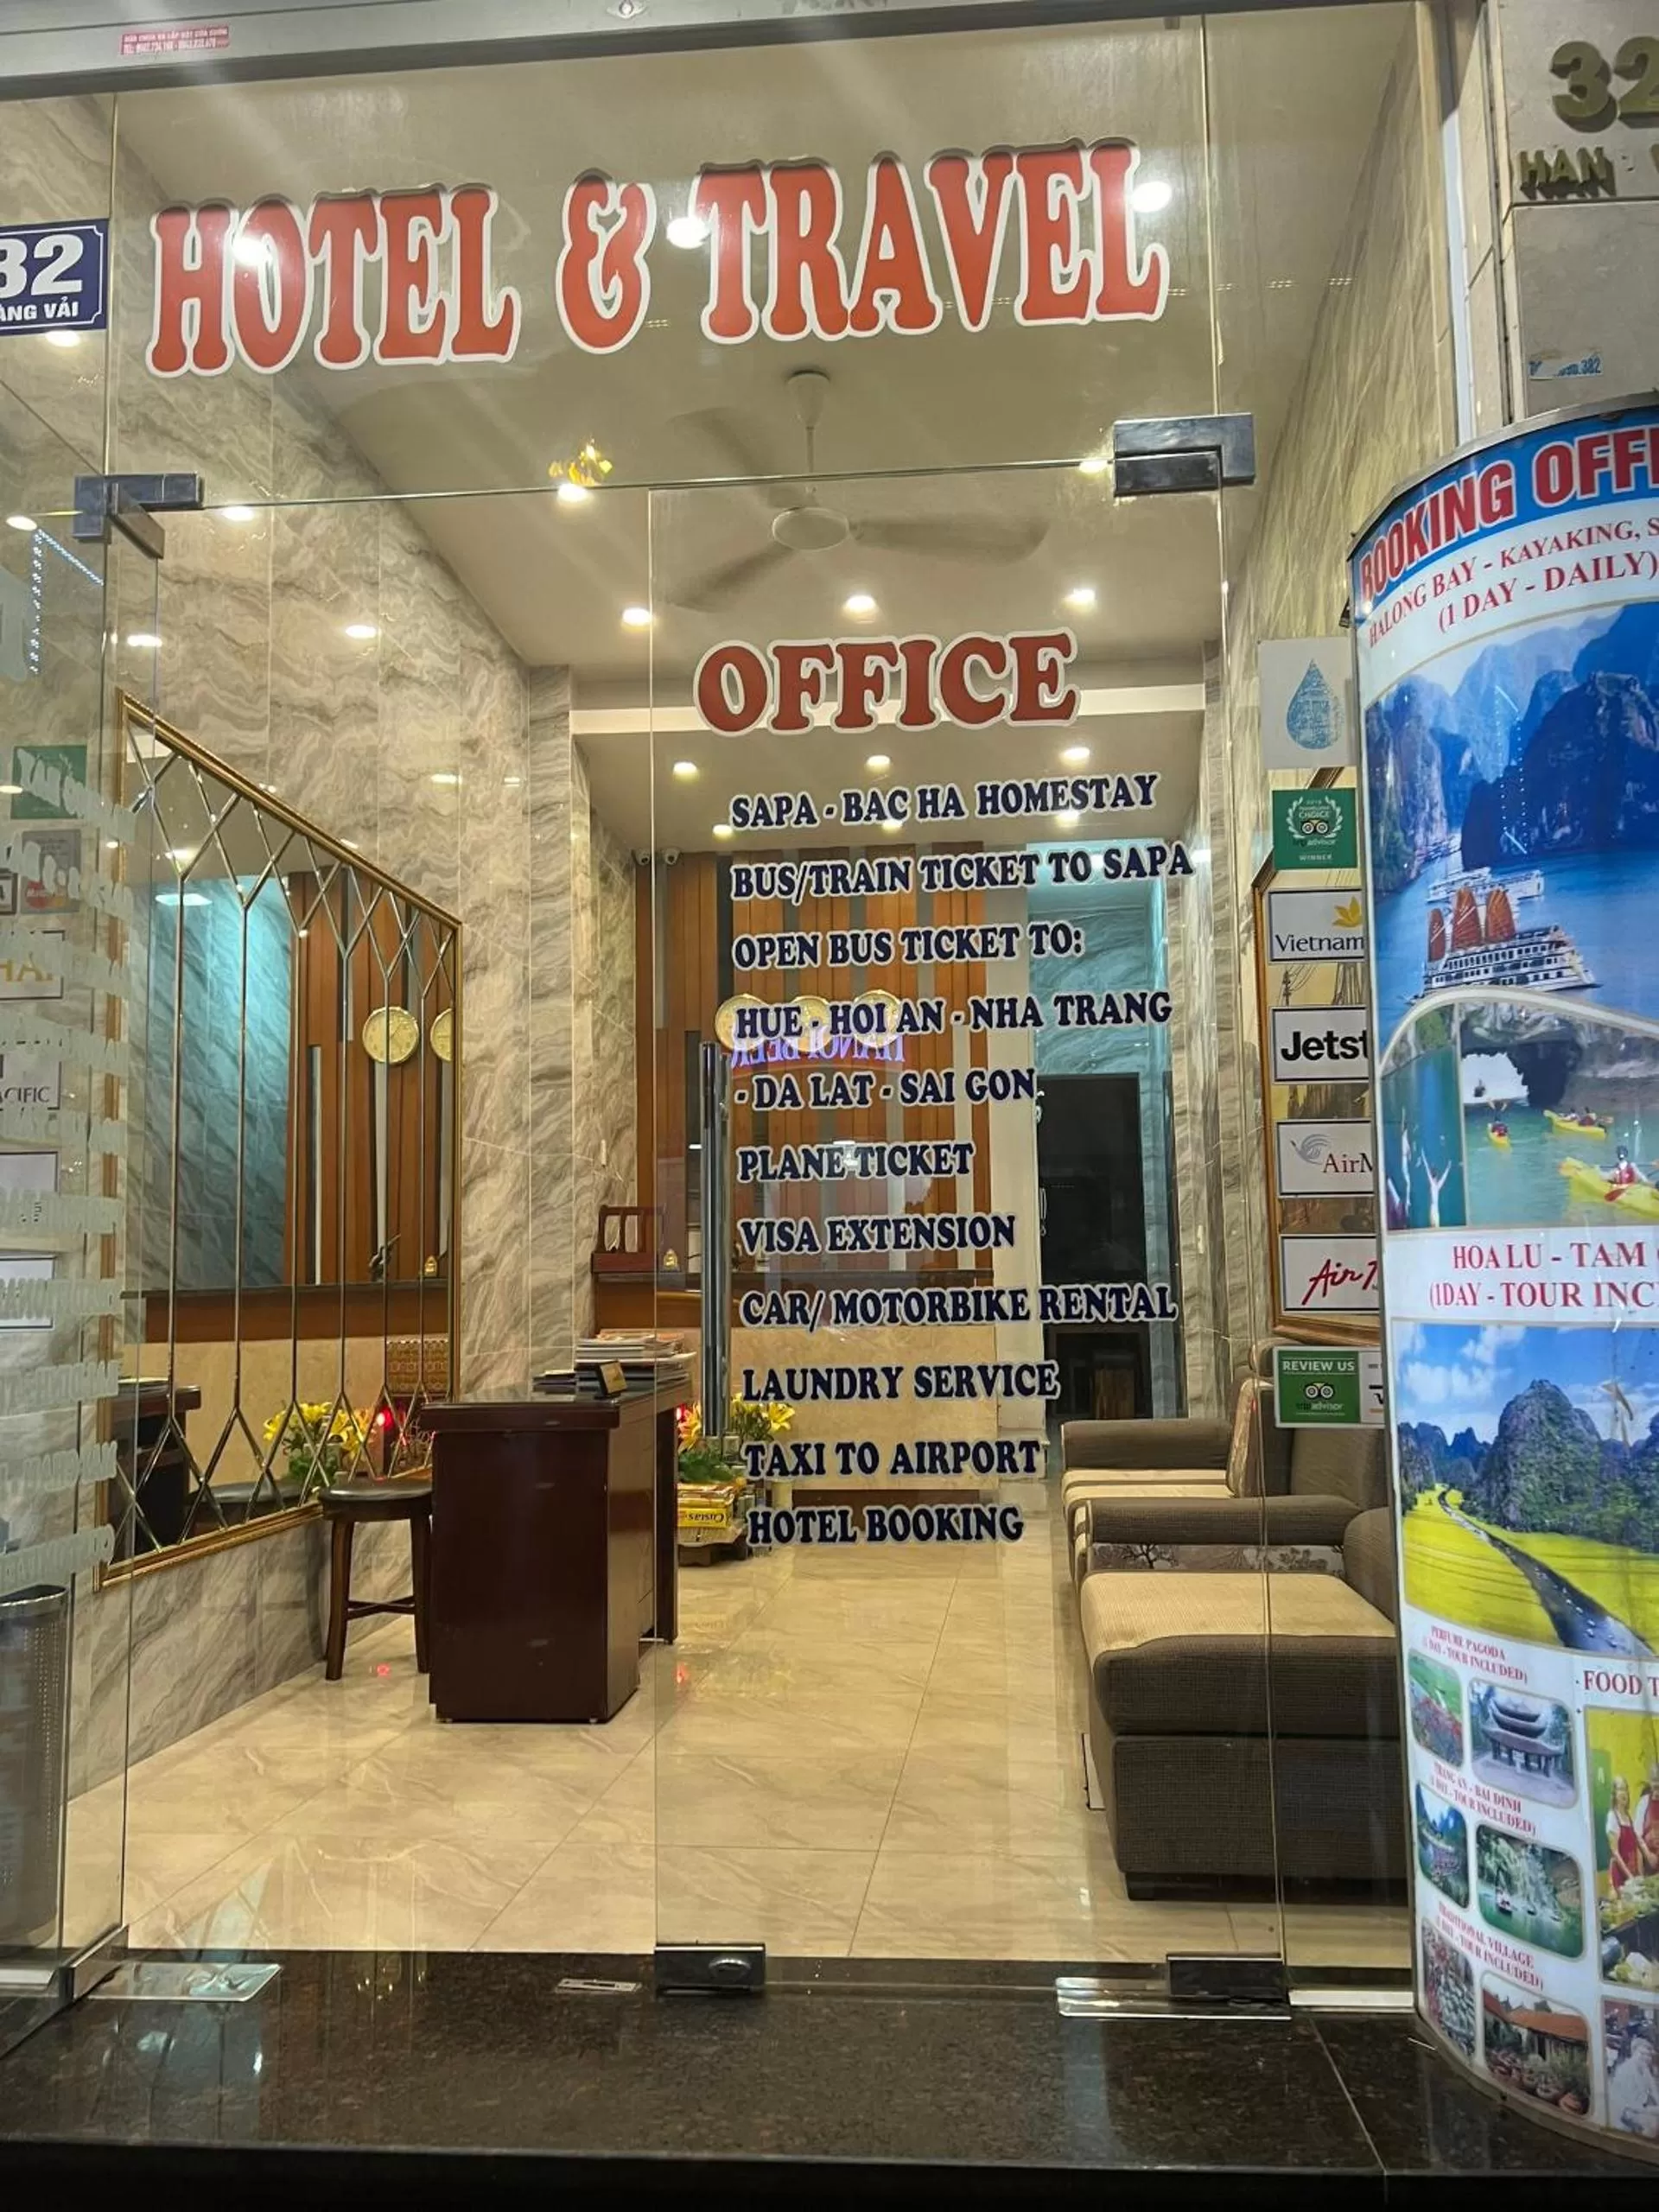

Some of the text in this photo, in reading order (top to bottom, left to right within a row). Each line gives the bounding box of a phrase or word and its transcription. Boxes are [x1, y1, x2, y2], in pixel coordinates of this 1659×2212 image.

[1552, 37, 1659, 132] 32
[146, 139, 1169, 378] HOTEL & TRAVEL
[44, 296, 79, 319] VẢI
[1360, 460, 1516, 602] BOOKING
[1369, 583, 1427, 648] HALONG
[1433, 556, 1477, 598] BAY
[1500, 521, 1641, 569] KAYAKING,
[1464, 578, 1516, 620] DAY
[1544, 550, 1658, 592] DAILY)
[693, 627, 1080, 737] OFFICE
[732, 796, 817, 829] SAPA
[842, 789, 909, 823] BAC
[918, 785, 965, 818] HA
[977, 774, 1159, 815] HOMESTAY
[734, 843, 1193, 905] BUS/TRAIN TICKET TO SAPA
[734, 923, 1084, 969] OPEN BUS TICKET TO:
[1275, 934, 1364, 952] Vietnam
[736, 1005, 804, 1039] HUE
[829, 1002, 887, 1035] HOI
[896, 1001, 944, 1033] AN
[972, 995, 1044, 1029] NHA
[1053, 991, 1173, 1026] TRANG
[0, 1086, 50, 1103] CIFIC
[753, 1076, 802, 1109] DA
[810, 1073, 874, 1107] LAT
[900, 1071, 955, 1104] SAI
[965, 1068, 1036, 1102] GON
[739, 1142, 974, 1182] PLANE TICKET
[741, 1216, 1016, 1254] VISA EXTENSION
[1569, 1242, 1646, 1268] TAM
[741, 1285, 1177, 1332] CAR/ MOTORBIKE RENTAL
[1500, 1282, 1584, 1307] TOUR
[1593, 1281, 1659, 1307] INC
[743, 1363, 1060, 1402] LAUNDRY SERVICE
[1282, 1361, 1355, 1371] REVIEW US
[746, 1440, 1041, 1478] TAXI TO AIRPORT
[748, 1506, 1024, 1545] HOTEL BOOKING
[1583, 1670, 1643, 1695] FOOD
